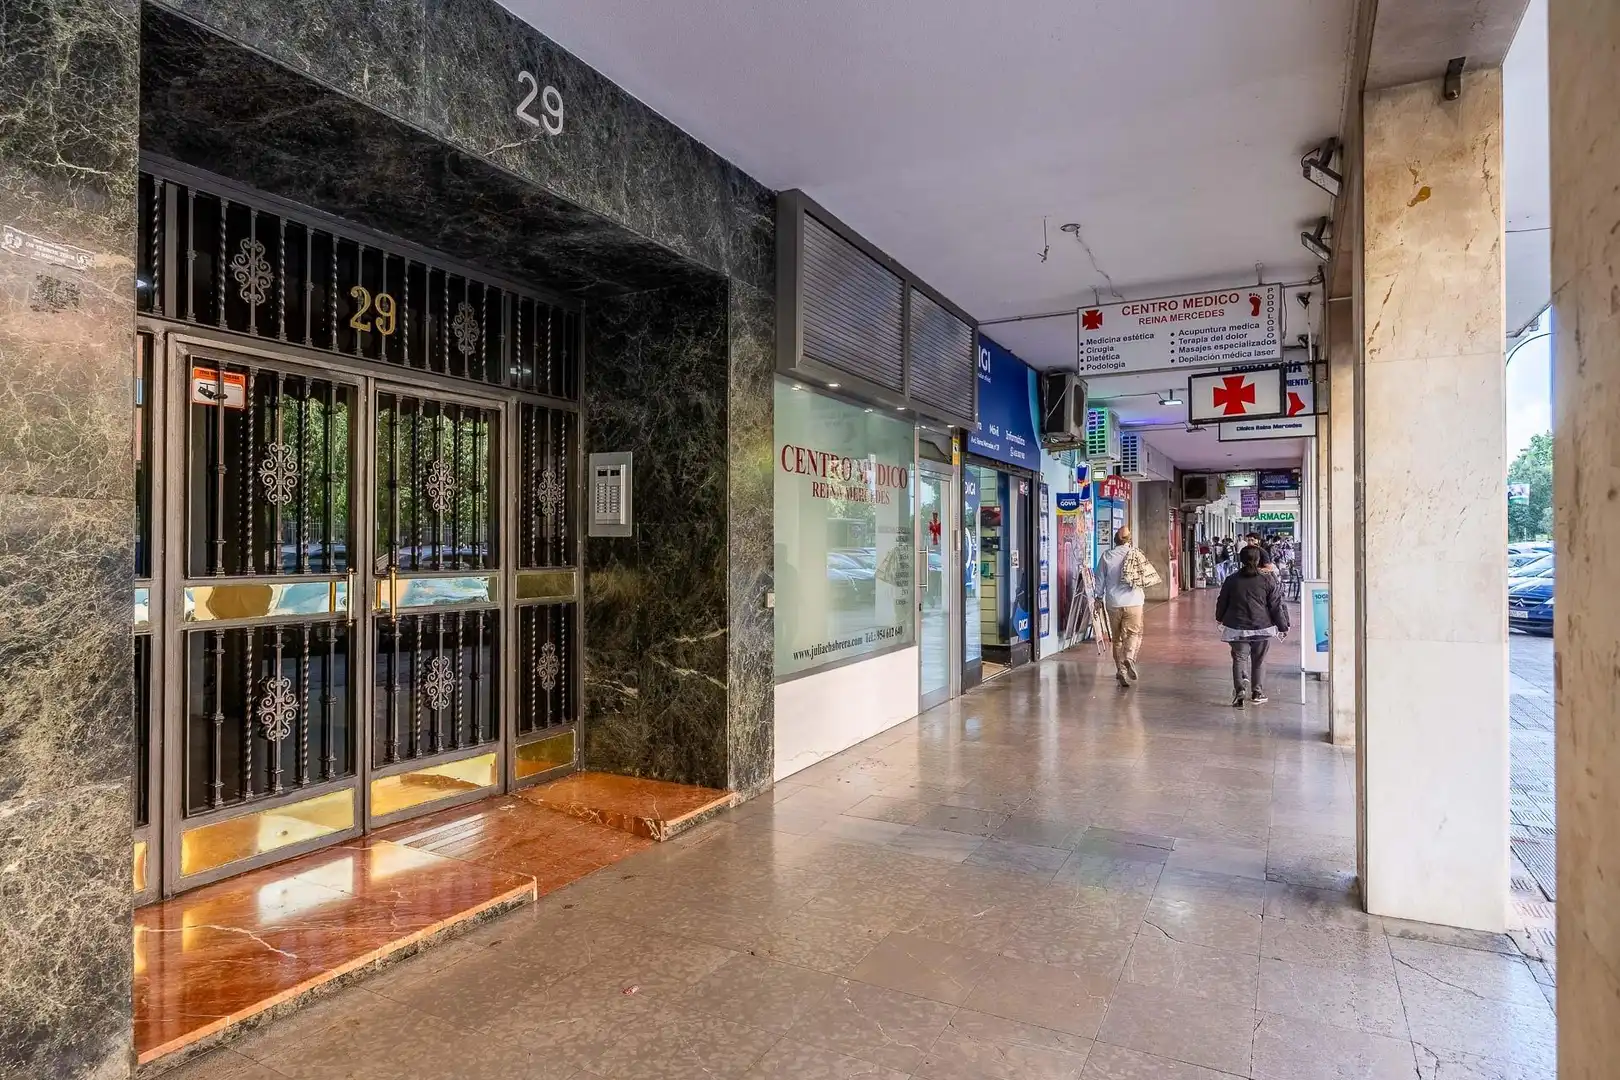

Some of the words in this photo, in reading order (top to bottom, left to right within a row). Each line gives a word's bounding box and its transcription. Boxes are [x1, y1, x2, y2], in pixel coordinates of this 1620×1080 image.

[517, 71, 563, 135] 29
[350, 286, 396, 335] 29
[1122, 300, 1178, 316] CENTRO
[1183, 292, 1240, 310] MEDICO
[1138, 315, 1168, 325] REINA
[1170, 309, 1224, 322] MERCEDES
[1266, 288, 1275, 338] PODOLOGO
[1086, 336, 1121, 346] Medicina
[1123, 332, 1155, 342] estética
[1178, 326, 1226, 337] Acupuntura
[1178, 337, 1208, 345] Terapia
[1211, 334, 1223, 342] del
[1225, 332, 1248, 340] dolor
[1178, 344, 1212, 353] Masajes
[1213, 338, 1277, 351] especializados
[978, 345, 991, 373] IGI
[1086, 353, 1120, 362] Dietética
[1178, 353, 1220, 363] Depilación
[1254, 349, 1275, 357] laser
[781, 444, 852, 482] CENTRO
[857, 459, 908, 489] MDICO
[1018, 618, 1028, 631] DIGI
[876, 628, 886, 640] 954
